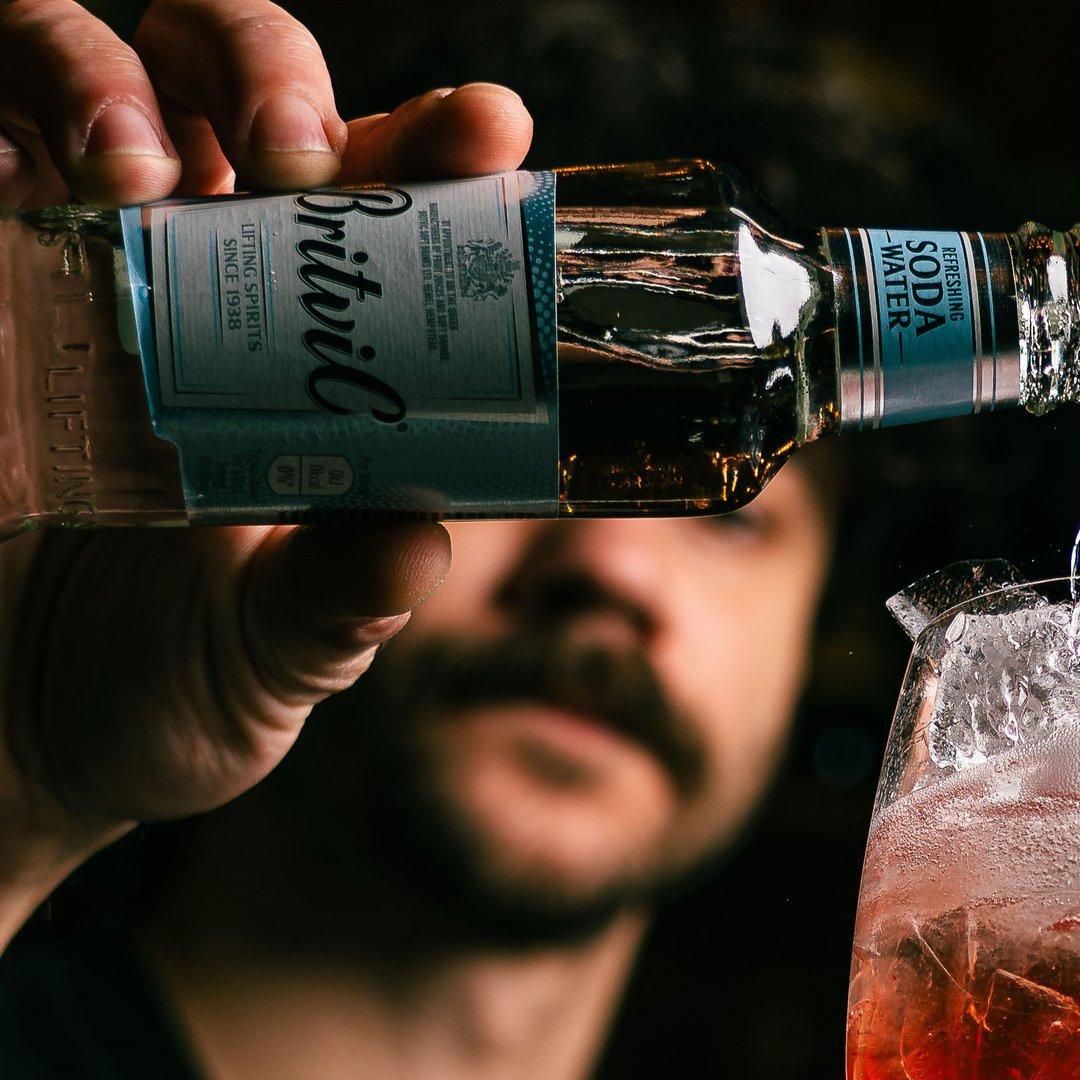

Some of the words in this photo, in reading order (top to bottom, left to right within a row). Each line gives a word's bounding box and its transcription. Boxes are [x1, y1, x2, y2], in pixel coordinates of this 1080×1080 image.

[223, 239, 239, 283] SINCE
[241, 224, 258, 278] LIFTING
[942, 247, 964, 321] REFRESHING
[226, 289, 242, 330] 1938
[244, 283, 262, 352] SPIRITS
[880, 244, 912, 332] WATER
[905, 240, 947, 337] SODA
